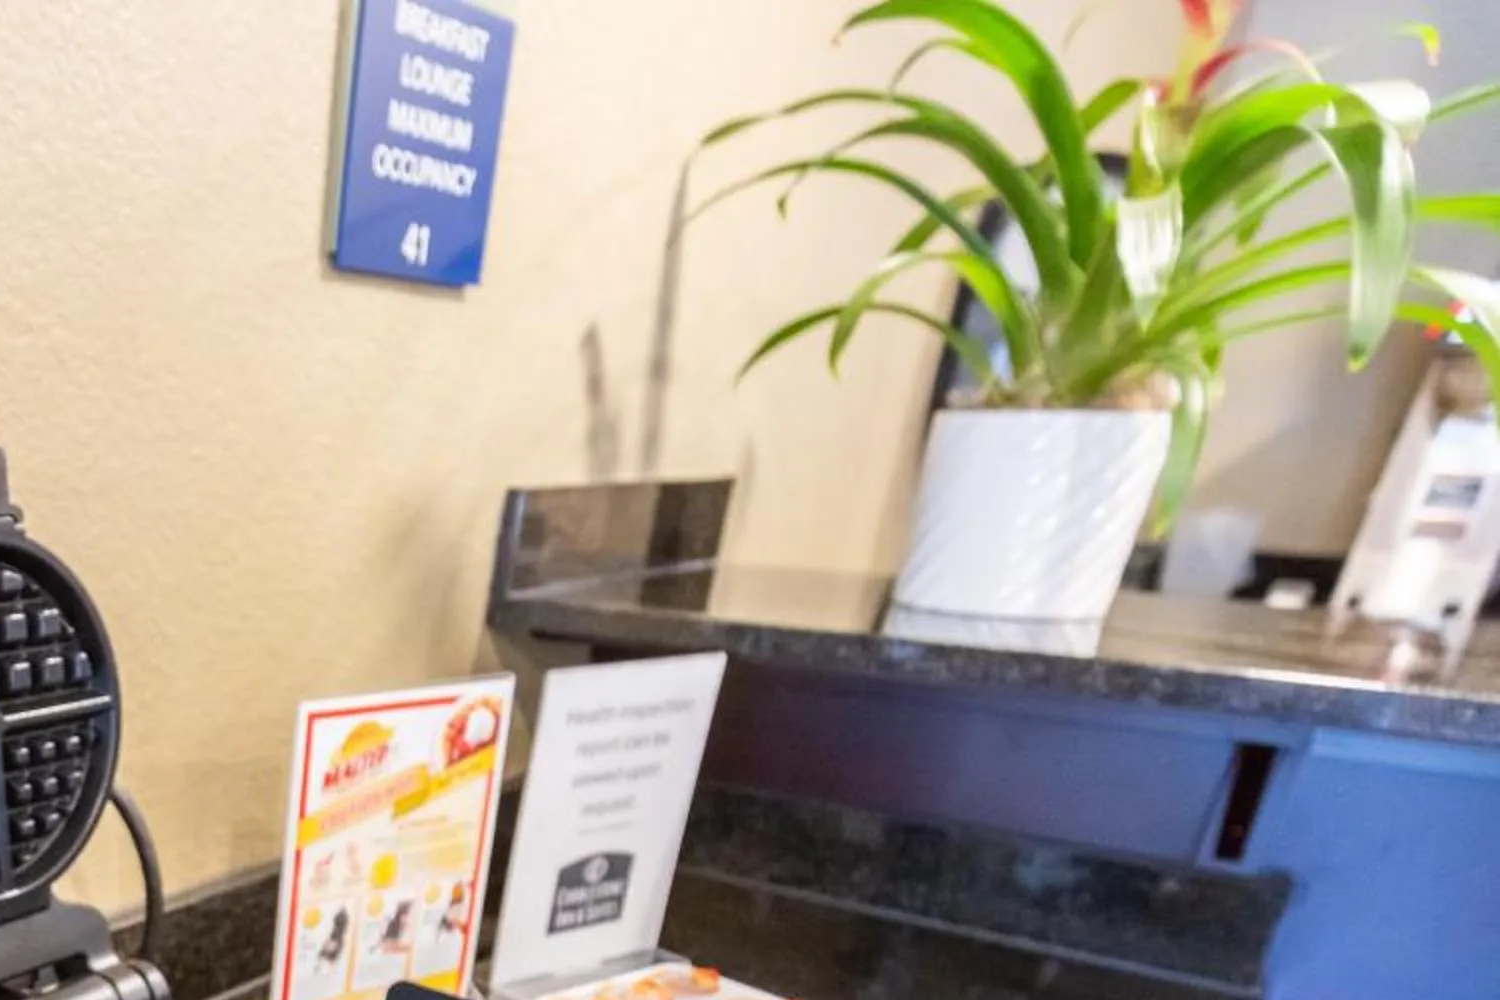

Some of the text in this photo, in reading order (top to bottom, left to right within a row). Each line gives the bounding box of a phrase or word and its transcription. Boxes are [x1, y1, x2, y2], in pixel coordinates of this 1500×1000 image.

[400, 52, 474, 107] LOUNGE
[387, 97, 474, 152] MAXIMUM
[371, 143, 477, 198] OCCUPANCY
[401, 221, 431, 267] 41
